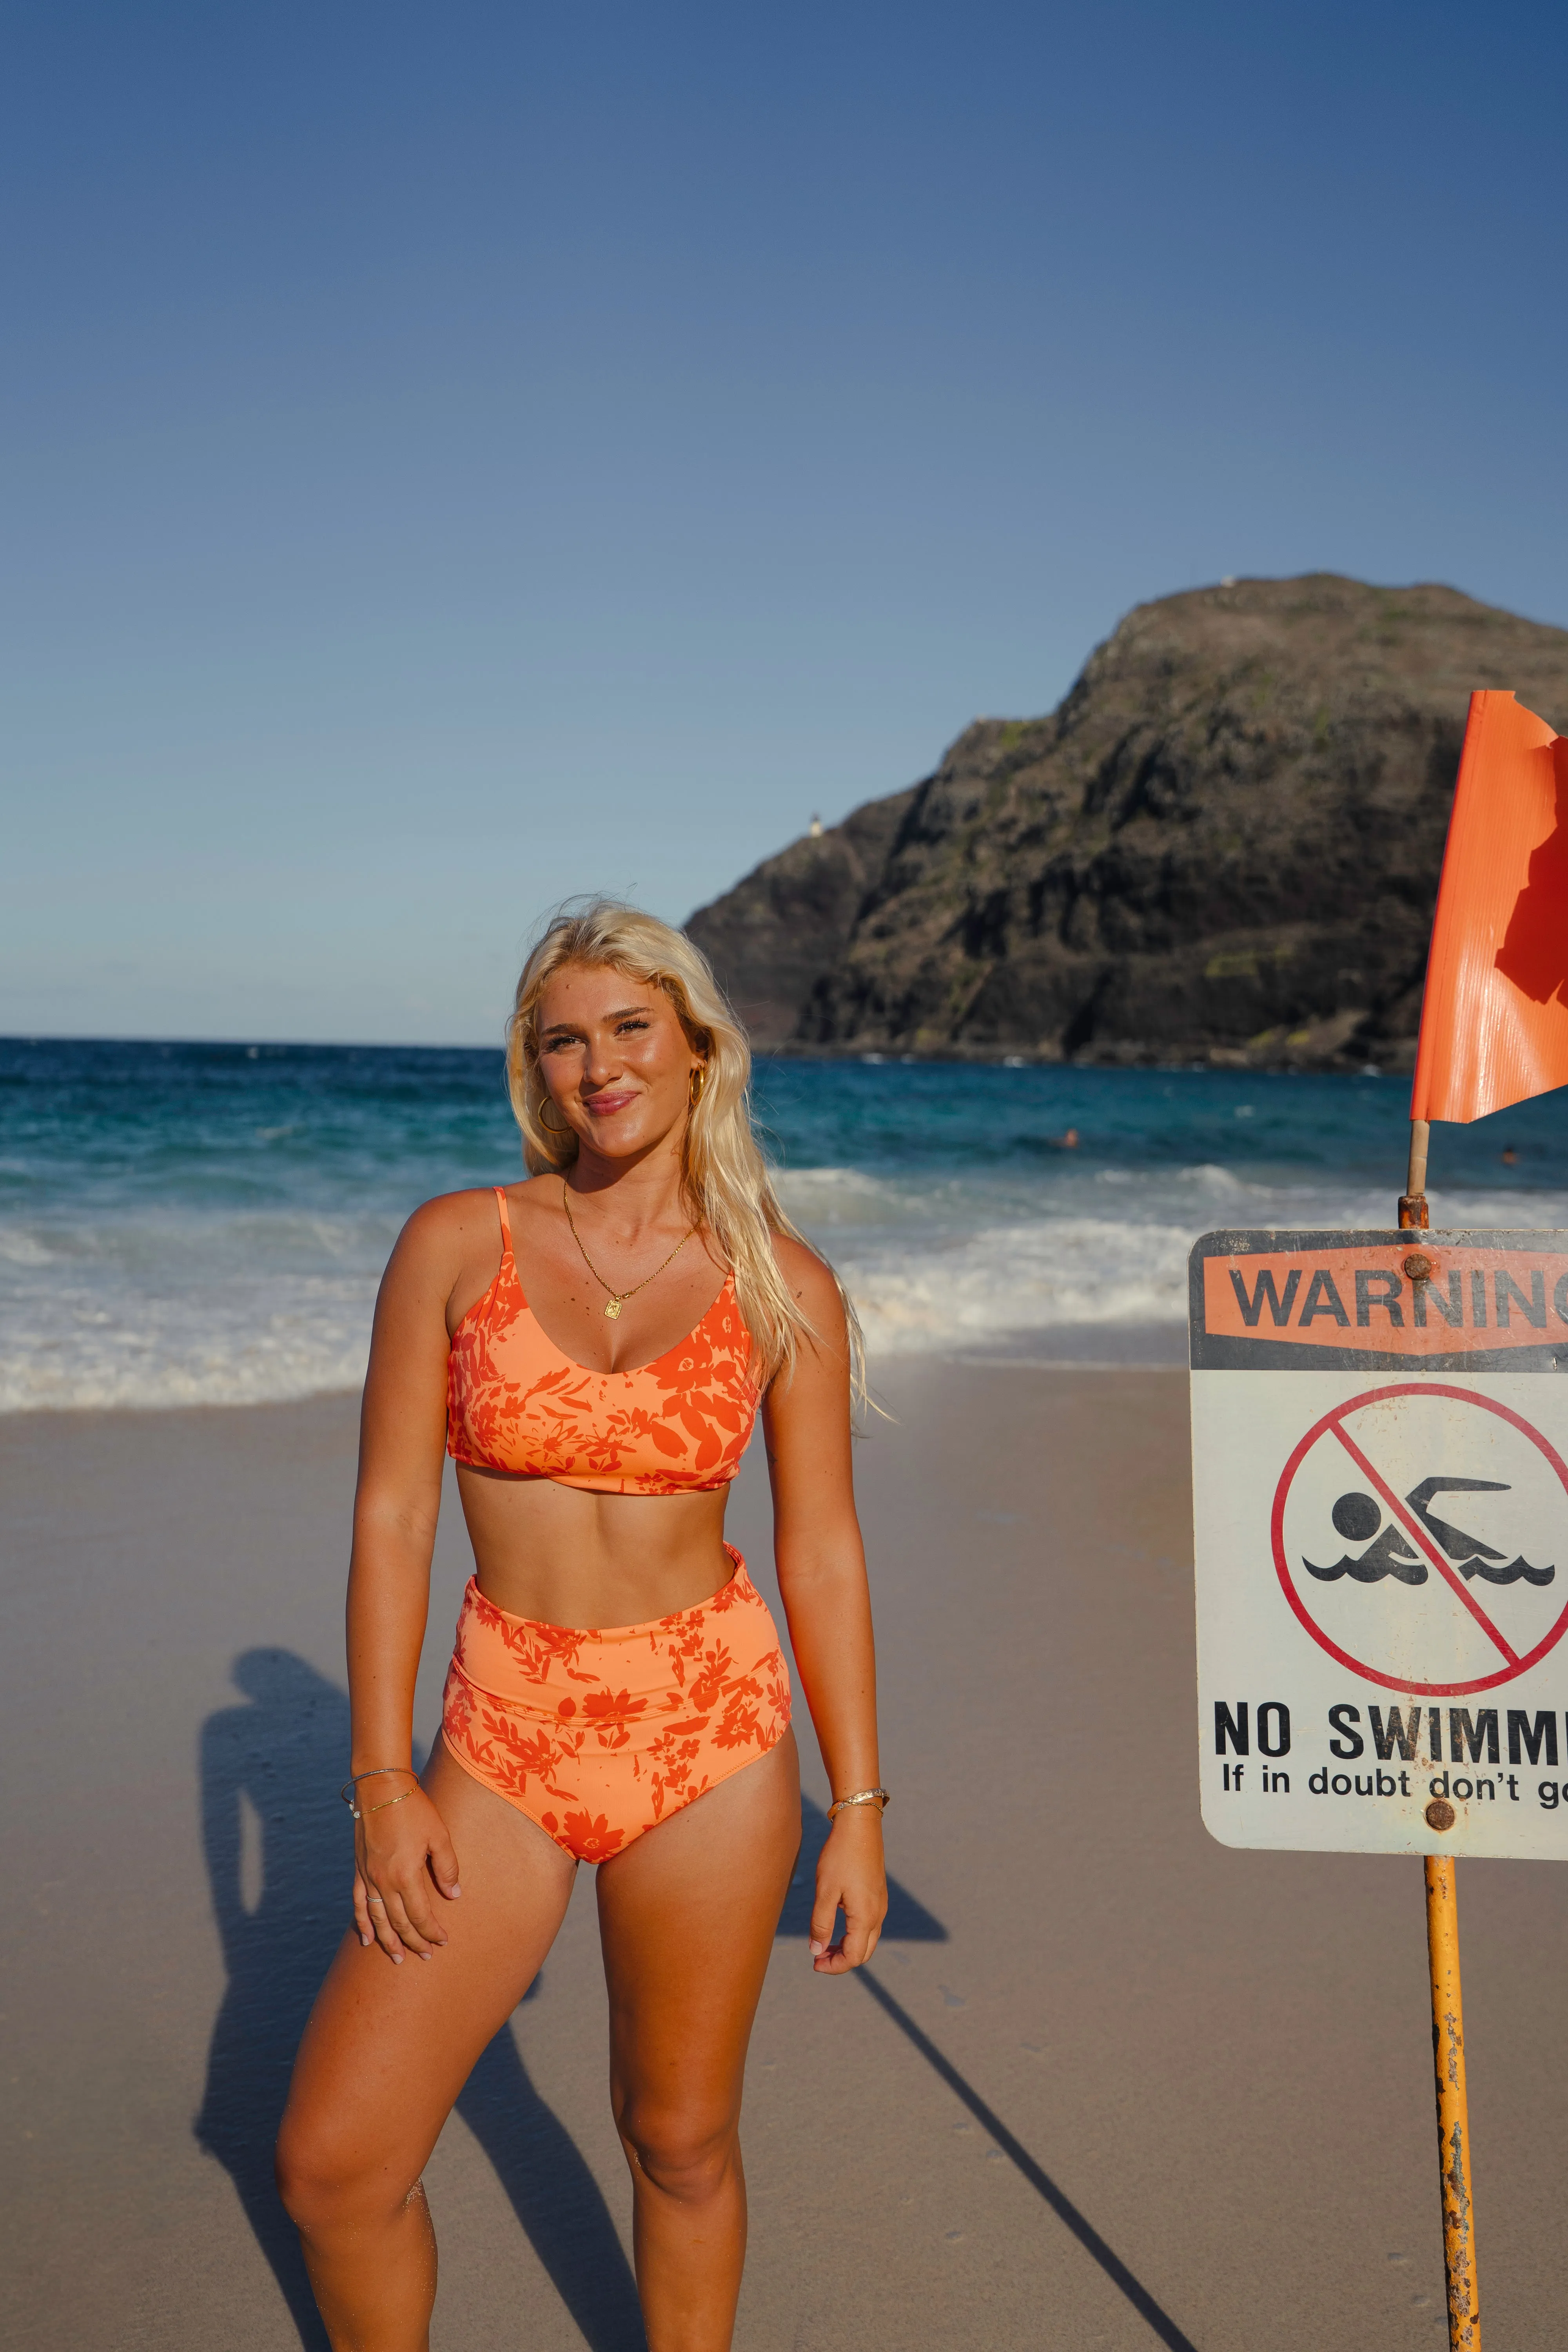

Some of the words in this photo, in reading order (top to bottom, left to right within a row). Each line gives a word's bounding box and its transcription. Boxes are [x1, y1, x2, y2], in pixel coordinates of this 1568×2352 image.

[1229, 1269, 1568, 1328] WARNIN
[1214, 1701, 1291, 1757] NO
[1328, 1704, 1568, 1766] SWIMM
[1223, 1763, 1244, 1792] If
[1263, 1765, 1290, 1793] in
[1308, 1767, 1411, 1797] doubt
[1429, 1771, 1520, 1801] don't
[1538, 1781, 1568, 1809] g
